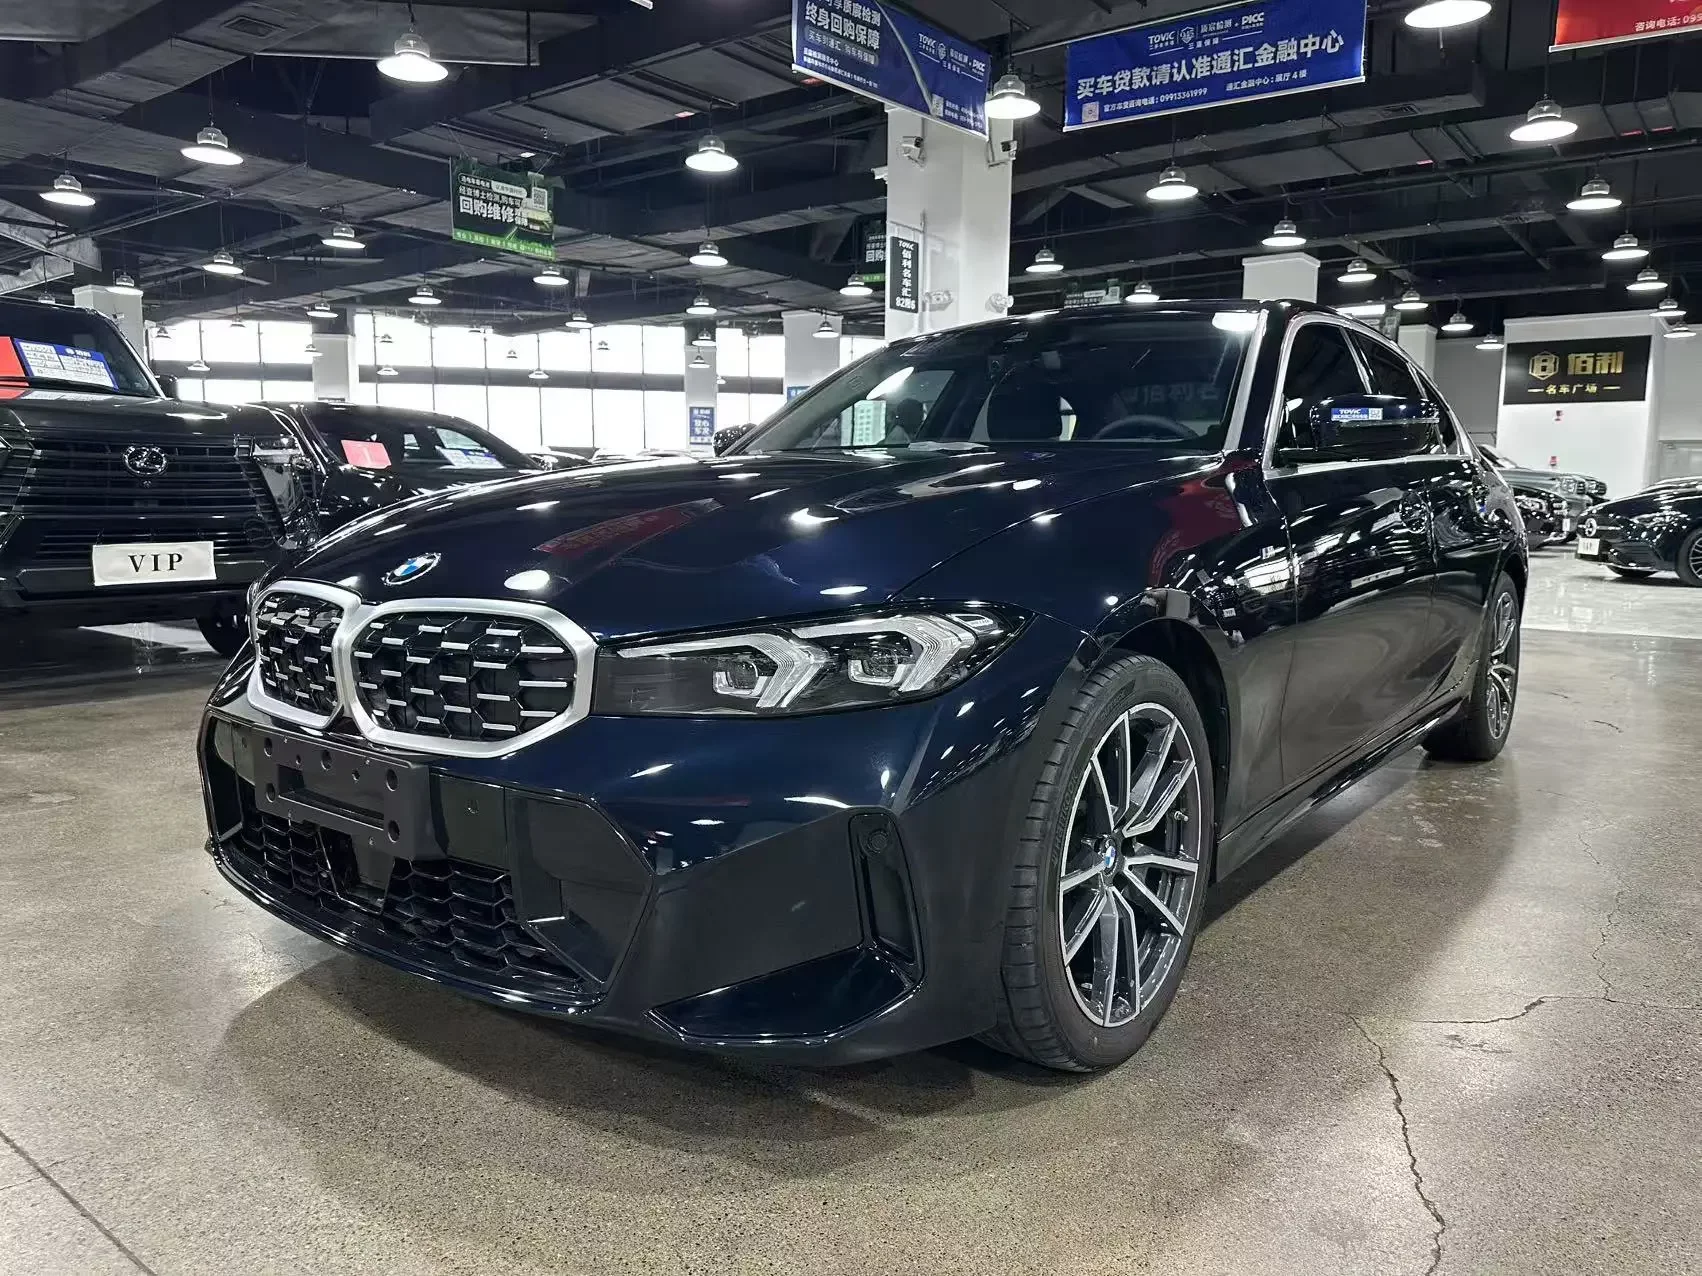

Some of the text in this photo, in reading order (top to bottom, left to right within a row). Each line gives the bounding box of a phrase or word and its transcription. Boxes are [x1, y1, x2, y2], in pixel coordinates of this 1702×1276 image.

[805, 1, 880, 50] 终身回购保障
[1148, 31, 1176, 44] TOVIC
[1077, 29, 1344, 99] 买车贷款请认准通汇金融中心
[459, 196, 514, 223] 回购维修
[1567, 351, 1624, 375] 佰利
[1546, 383, 1598, 395] 名车广场
[128, 553, 183, 573] VIP
